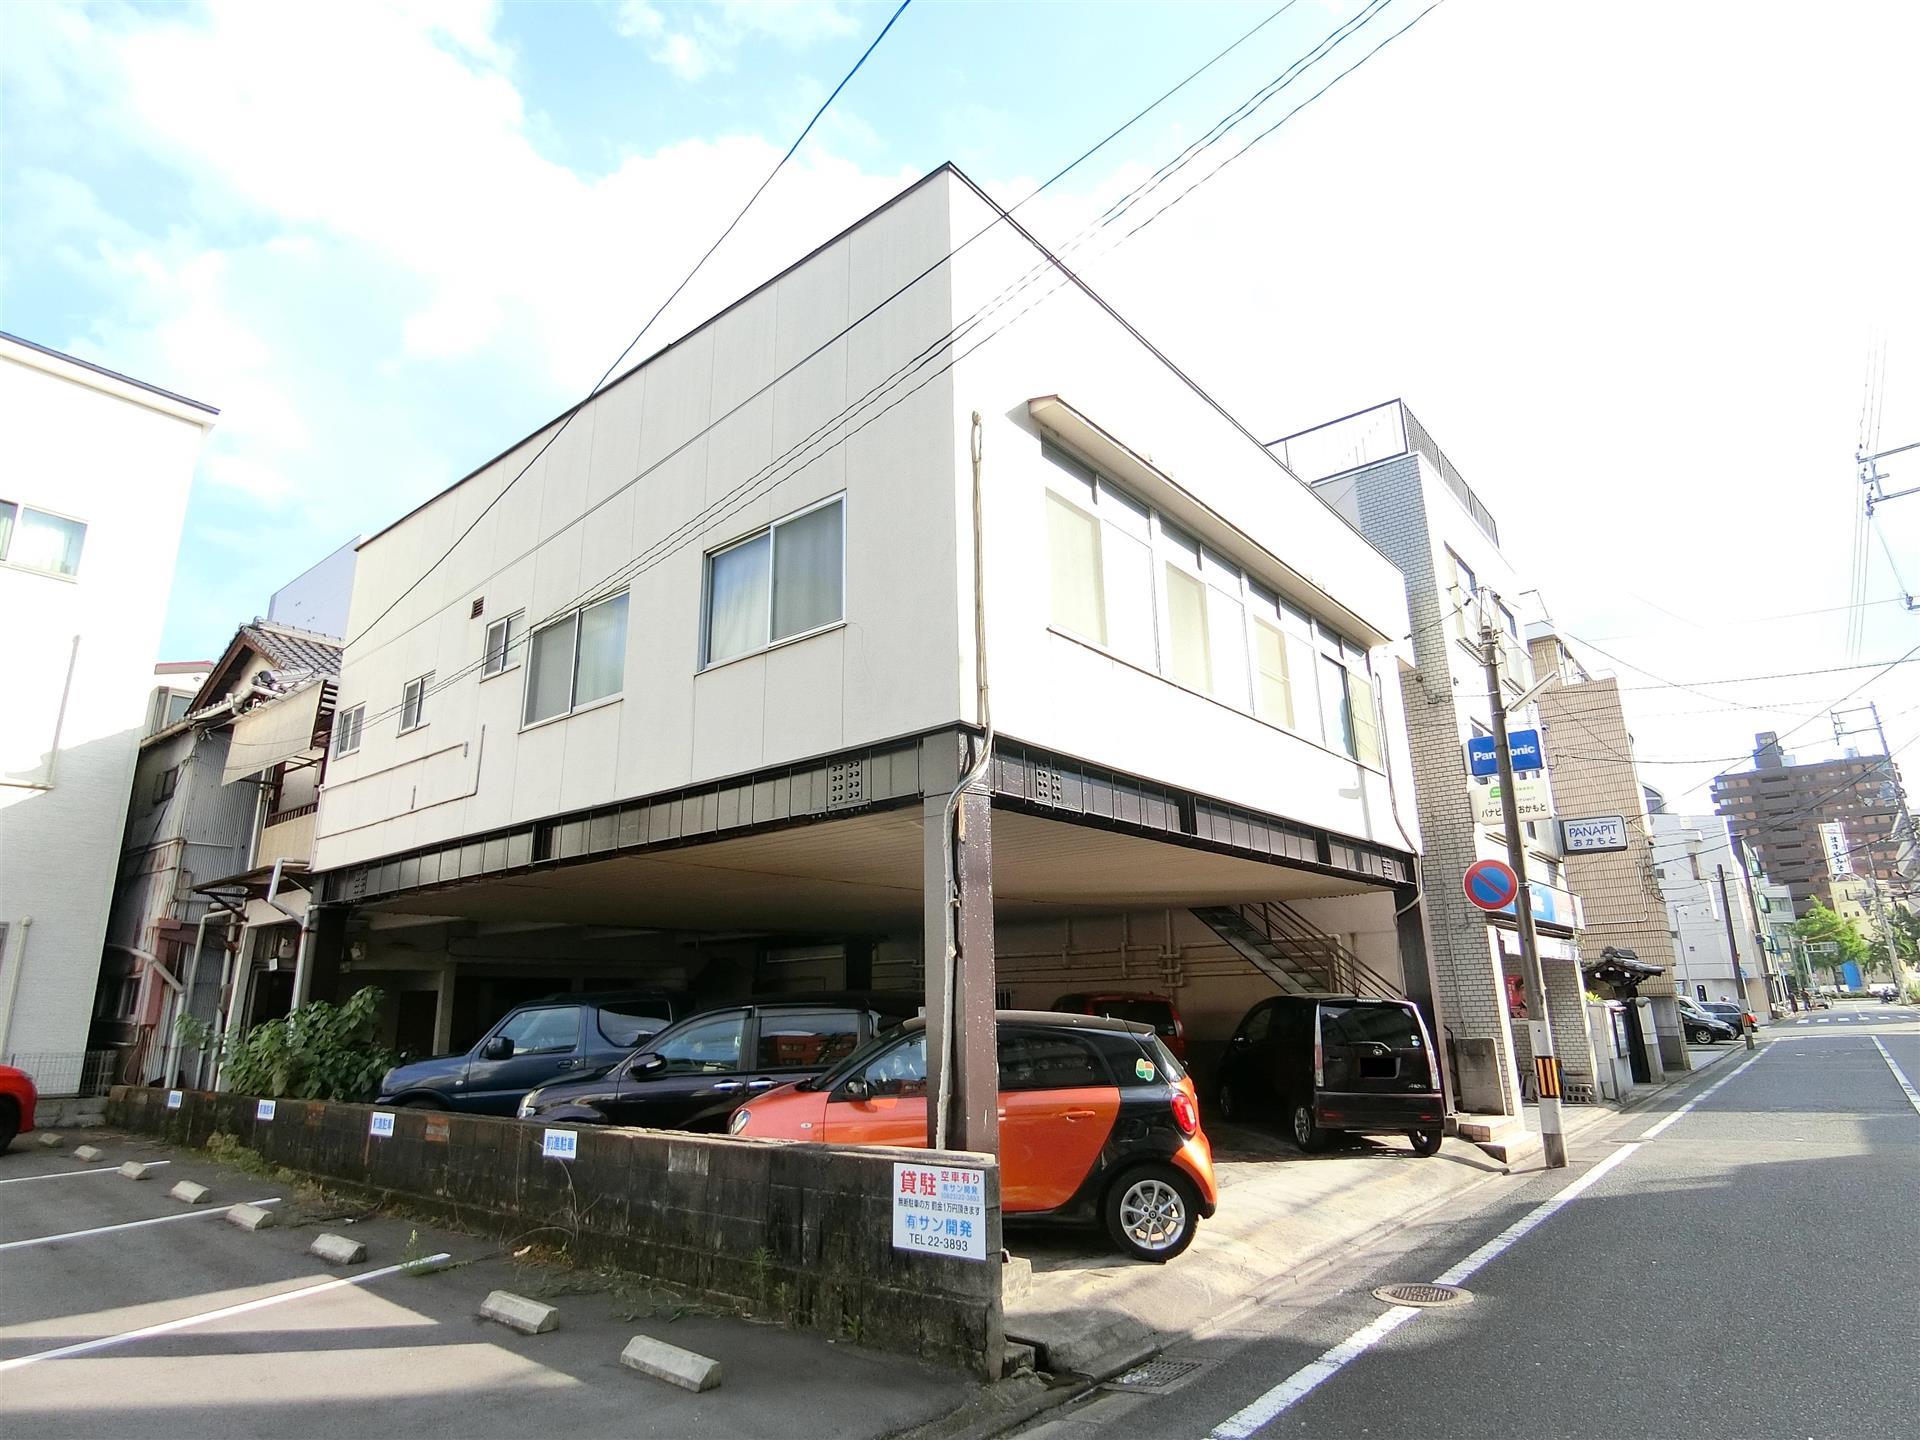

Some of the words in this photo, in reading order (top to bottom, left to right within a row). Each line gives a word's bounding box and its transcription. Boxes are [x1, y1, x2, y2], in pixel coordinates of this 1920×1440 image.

[1473, 745, 1535, 761] Panonic
[1569, 824, 1617, 837] PANAPIT
[1573, 836, 1617, 847] おかもと
[900, 1169, 937, 1196] 貸駐
[941, 1170, 980, 1184] 空車有り
[909, 1233, 925, 1246] TEL
[927, 1235, 968, 1251] 22-3893
